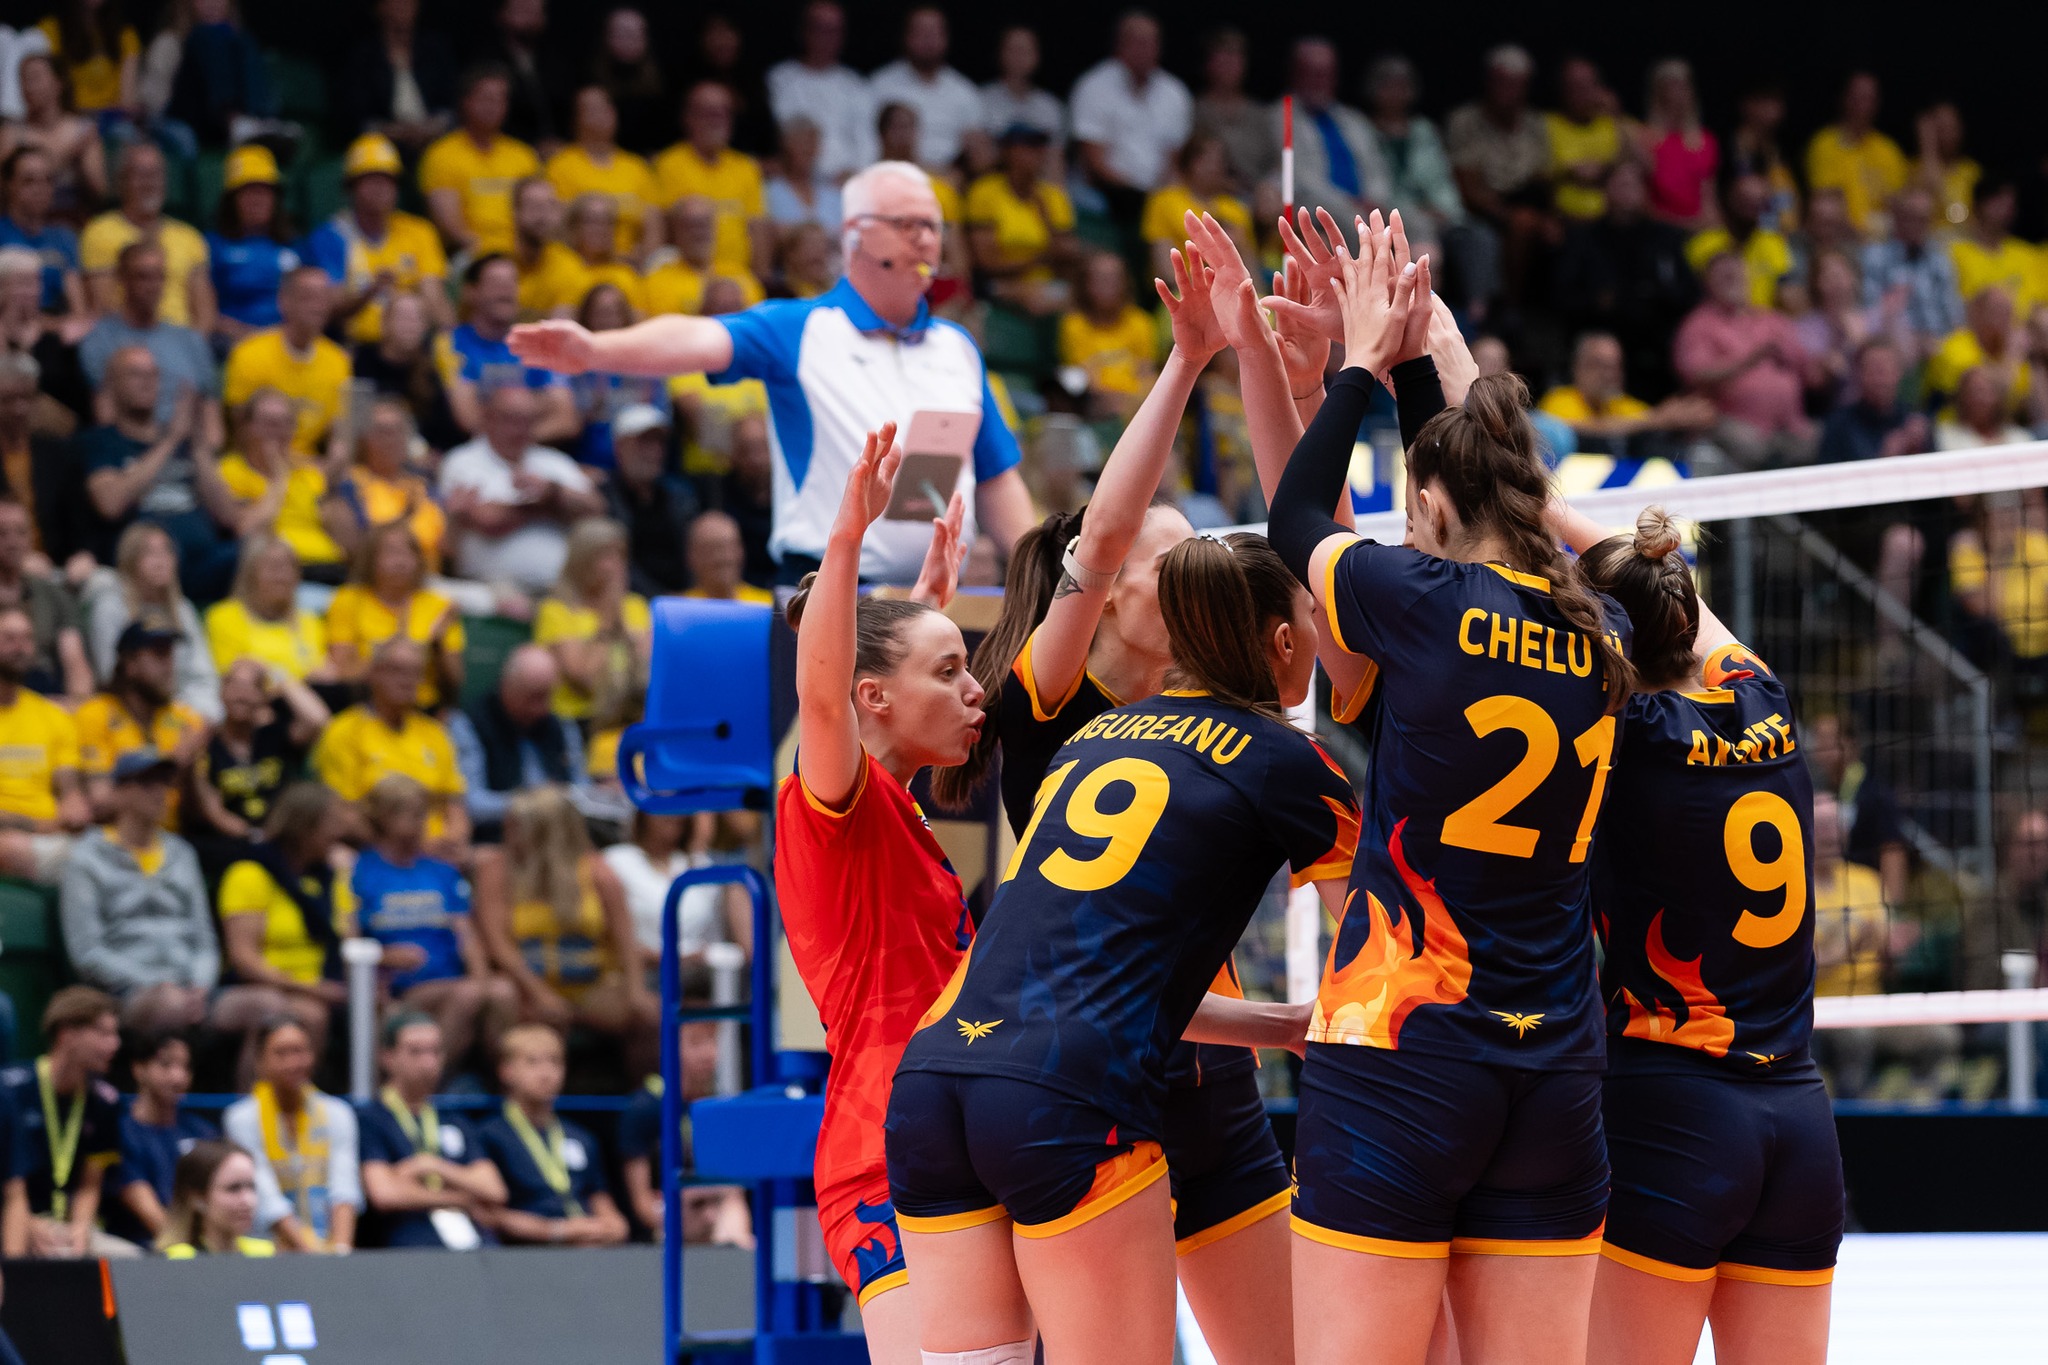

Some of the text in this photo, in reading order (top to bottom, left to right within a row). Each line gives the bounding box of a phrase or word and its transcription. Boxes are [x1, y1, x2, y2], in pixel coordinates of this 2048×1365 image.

[1458, 607, 1624, 691] CHELU
[1063, 713, 1253, 765] NGUREANU
[1440, 695, 1616, 863] 21
[1001, 757, 1170, 891] 19
[1724, 791, 1806, 948] 9
